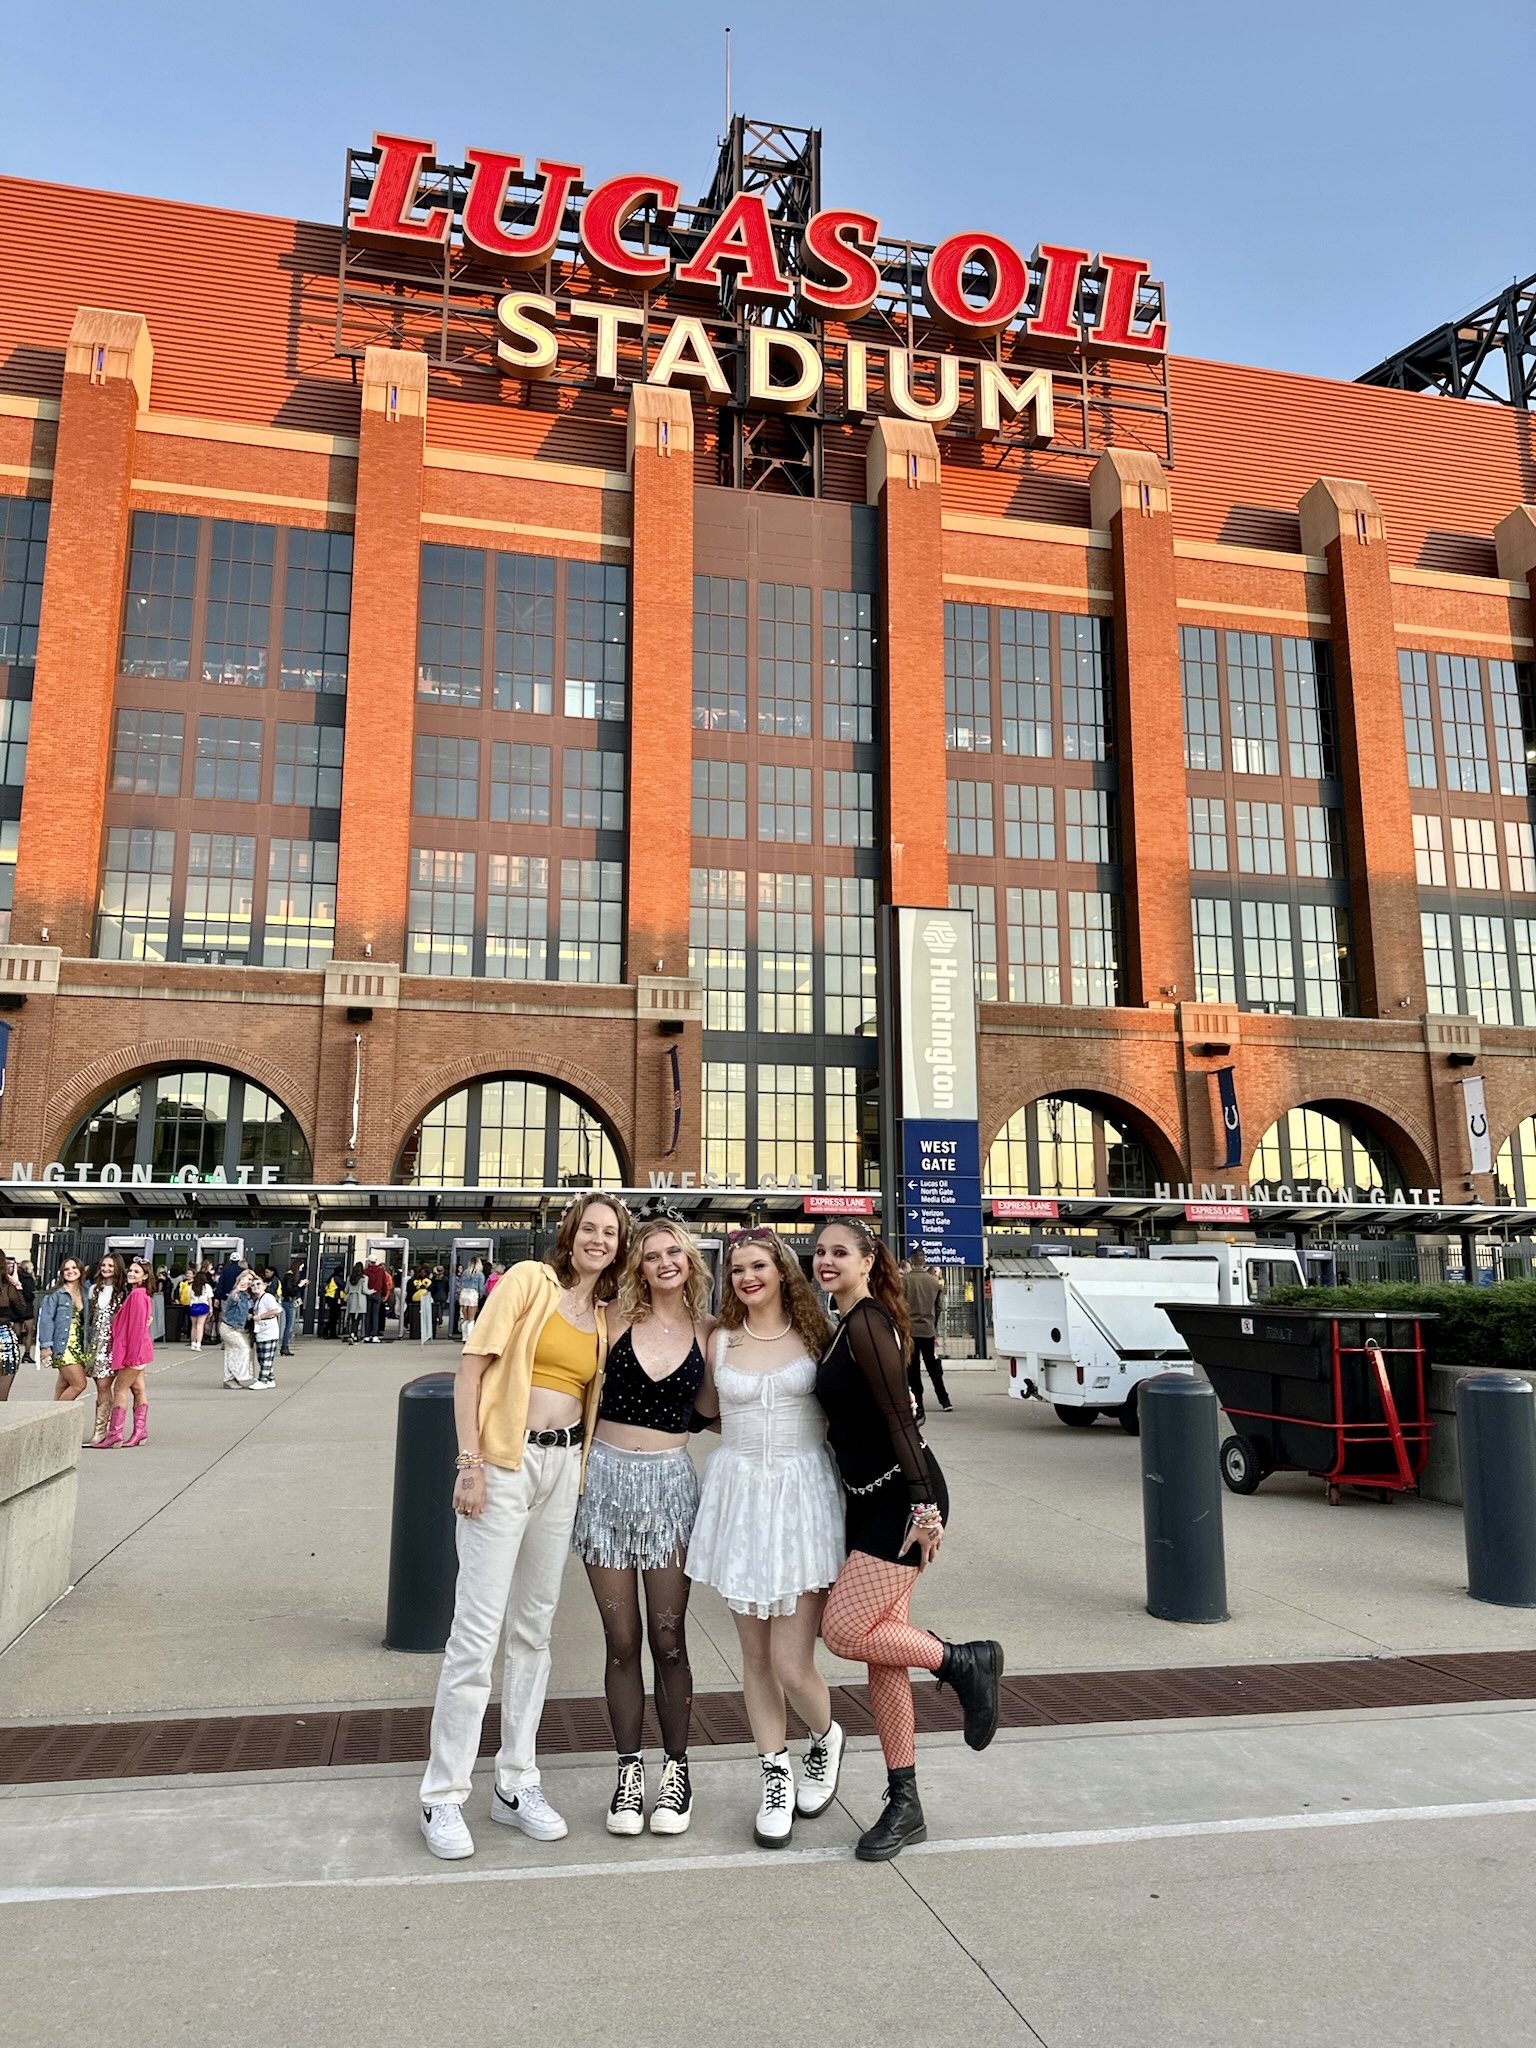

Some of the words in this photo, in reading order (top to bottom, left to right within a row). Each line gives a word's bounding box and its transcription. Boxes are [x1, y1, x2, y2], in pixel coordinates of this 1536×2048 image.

[349, 131, 883, 315] LUCAS
[924, 231, 1170, 355] OIL
[496, 292, 1055, 446] STADIUM
[924, 958, 957, 1110] Huntington
[920, 1140, 957, 1154] WEST
[921, 1158, 957, 1171] GATE
[178, 1164, 280, 1185] GATE
[648, 1171, 741, 1190] WEST
[760, 1173, 844, 1191] GATE
[938, 1180, 949, 1188] Oil
[938, 1188, 954, 1196] Gate
[1154, 1182, 1353, 1204] HUNTINGTON
[1370, 1187, 1441, 1206] GATE
[810, 1197, 845, 1207] EXPRESS
[845, 1198, 866, 1207] LANE
[941, 1196, 956, 1204] Gate
[997, 1201, 1031, 1210] EXPRESS
[1032, 1201, 1052, 1211] LANE
[1190, 1205, 1223, 1215] EXPRESS
[1223, 1206, 1243, 1216] LANE
[174, 1209, 193, 1219] W4
[408, 1211, 427, 1221] W5
[921, 1209, 944, 1217] Verizon
[921, 1217, 935, 1225] East
[936, 1217, 951, 1225] Gate
[922, 1225, 945, 1233] Tickets
[1367, 1225, 1386, 1235] W10
[922, 1247, 941, 1255] South
[941, 1247, 957, 1255] Gate
[941, 1256, 966, 1265] Parking
